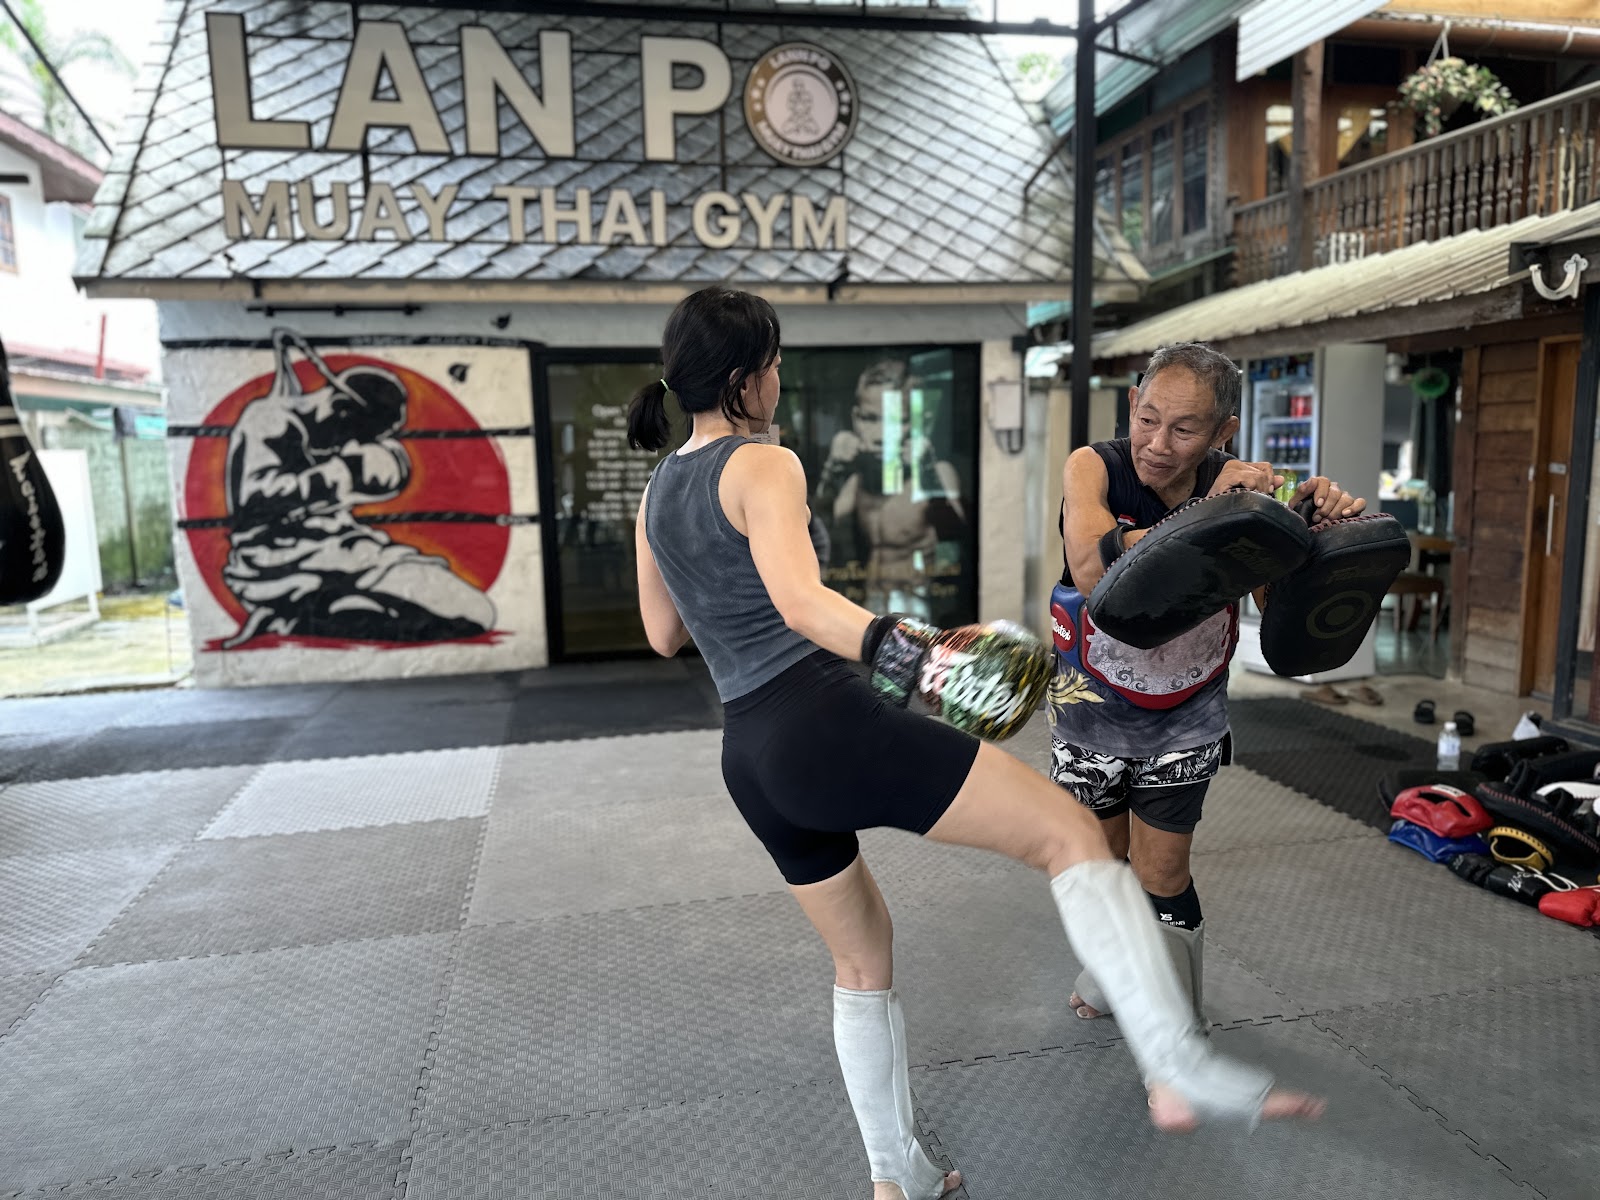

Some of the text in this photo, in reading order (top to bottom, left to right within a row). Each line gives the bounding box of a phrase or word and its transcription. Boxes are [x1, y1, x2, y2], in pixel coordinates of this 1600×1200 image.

[206, 12, 576, 159] LAN
[221, 180, 848, 250] MUAY THAI GYM
